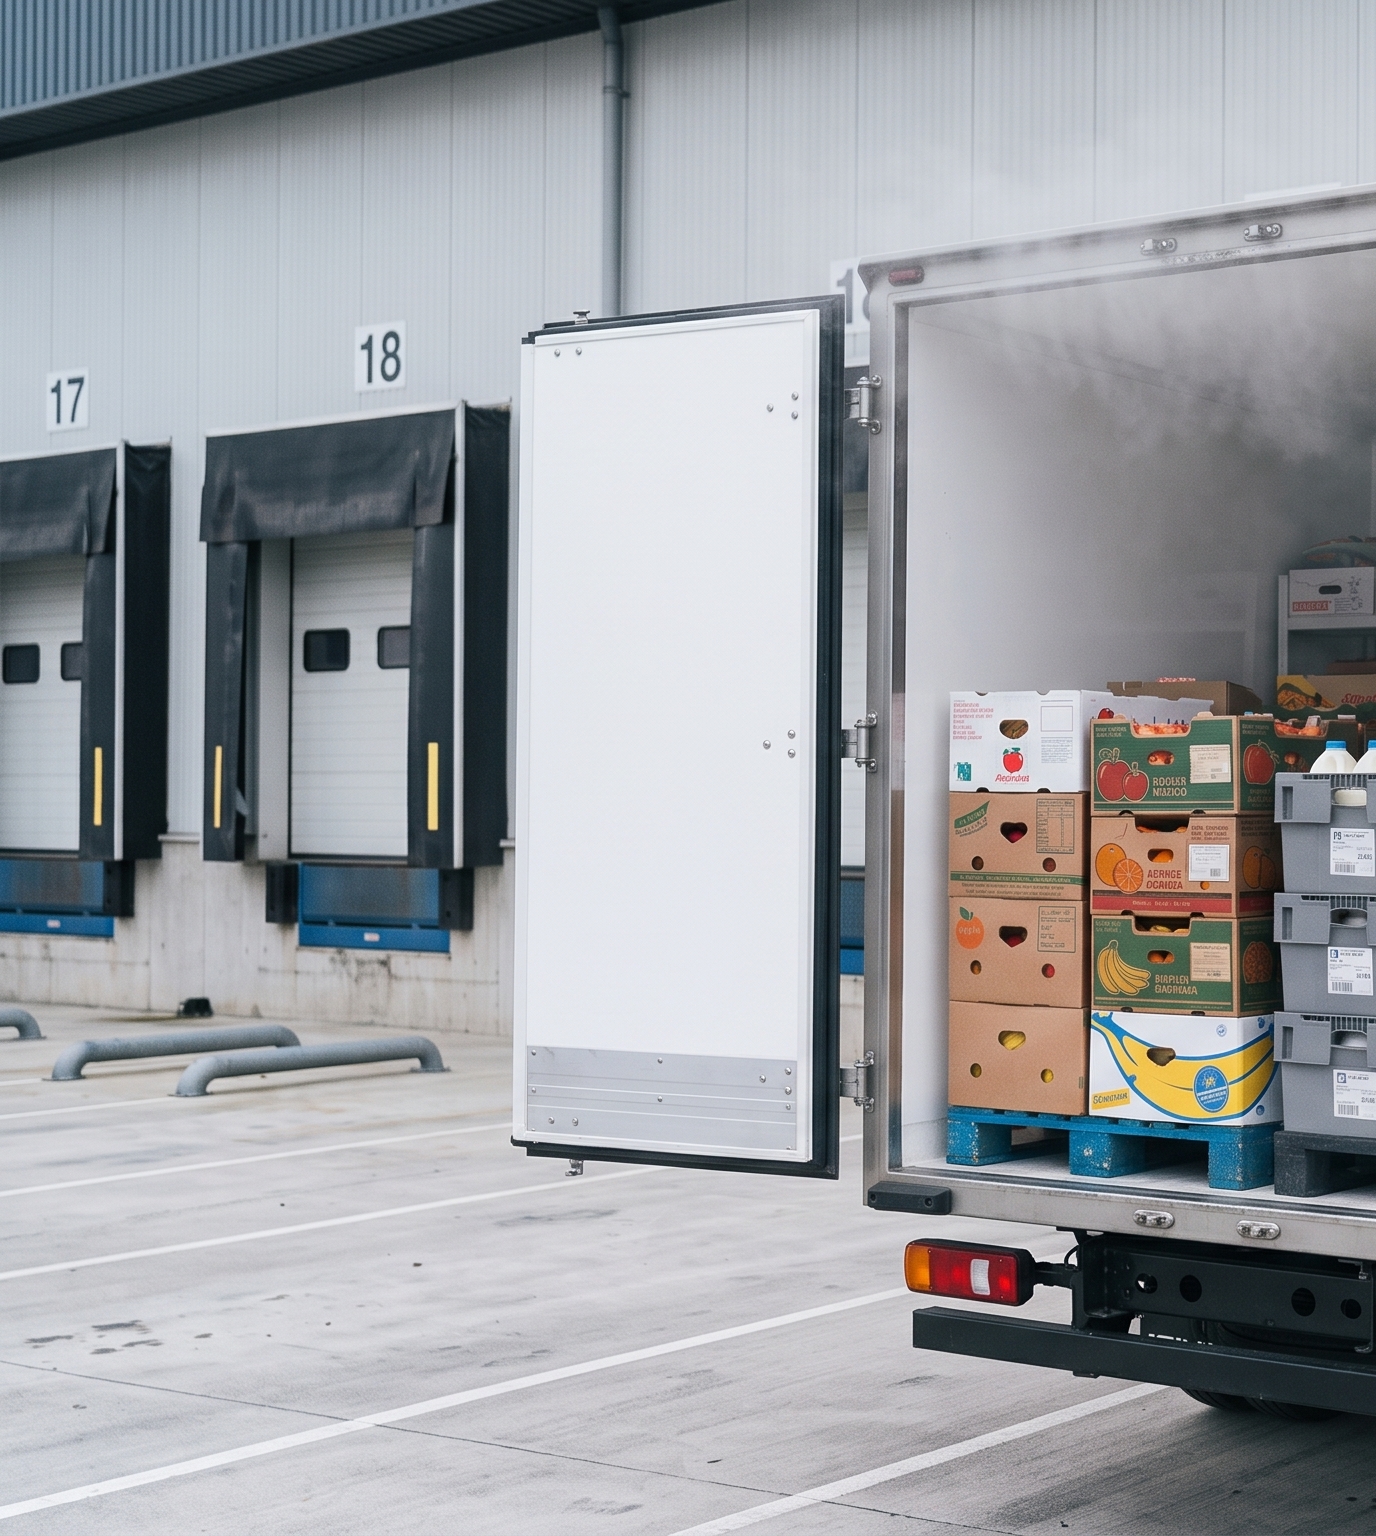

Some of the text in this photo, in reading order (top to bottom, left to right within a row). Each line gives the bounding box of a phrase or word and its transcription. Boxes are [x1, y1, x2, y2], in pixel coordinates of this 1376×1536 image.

[836, 267, 870, 324] 1
[360, 330, 401, 384] 18
[50, 377, 85, 424] 17
